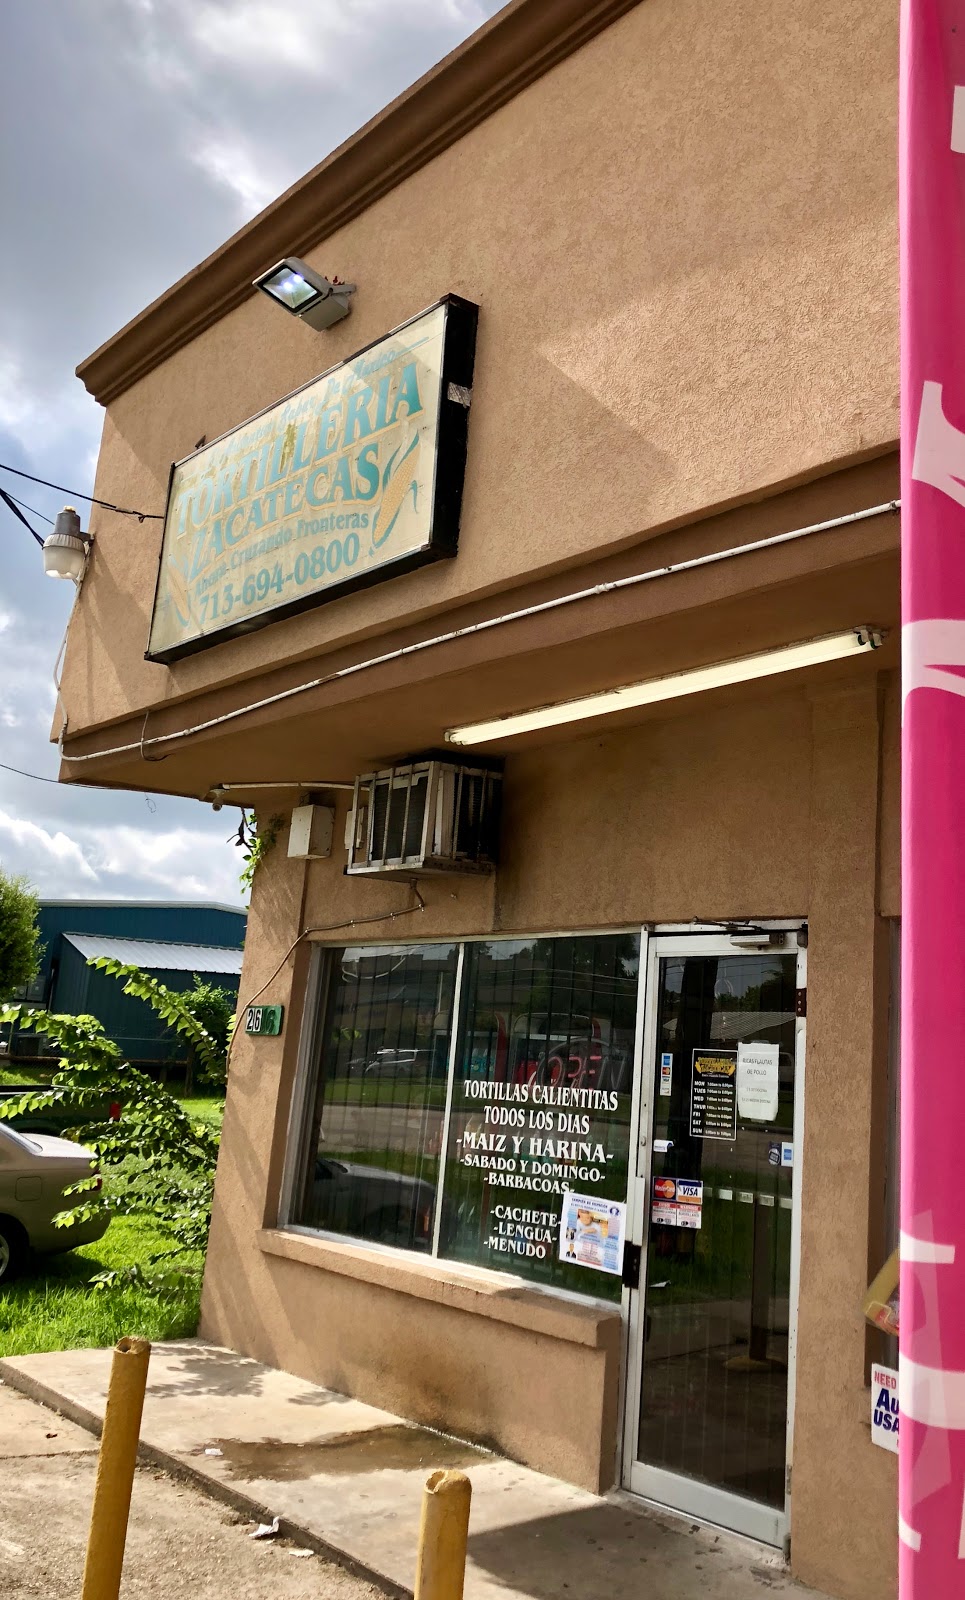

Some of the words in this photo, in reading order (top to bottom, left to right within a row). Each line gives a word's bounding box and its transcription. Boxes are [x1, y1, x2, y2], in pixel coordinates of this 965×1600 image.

[177, 362, 425, 537] TORTILLERIA
[189, 443, 382, 582] ZACATECAS
[230, 527, 293, 570] Cruzando
[297, 512, 369, 539] Fronteras
[199, 532, 360, 625] 713-694-0800
[464, 1080, 529, 1102] TORTILLAS
[532, 1085, 618, 1111] CALIENTITAS
[484, 1105, 525, 1128] TODOS
[529, 1109, 553, 1131] LOS
[558, 1113, 590, 1135] DIAS
[456, 1132, 507, 1153] -MAIZ
[512, 1136, 524, 1155] Y
[529, 1137, 614, 1164] HARINA-
[460, 1154, 516, 1172] -SABADO
[519, 1160, 529, 1173] Y
[532, 1161, 606, 1183] DOMINGO-
[682, 1187, 698, 1196] VISA
[483, 1236, 546, 1259] -MENUDO
[493, 1221, 558, 1244] -LENGUA-
[874, 1371, 896, 1389] NEED
